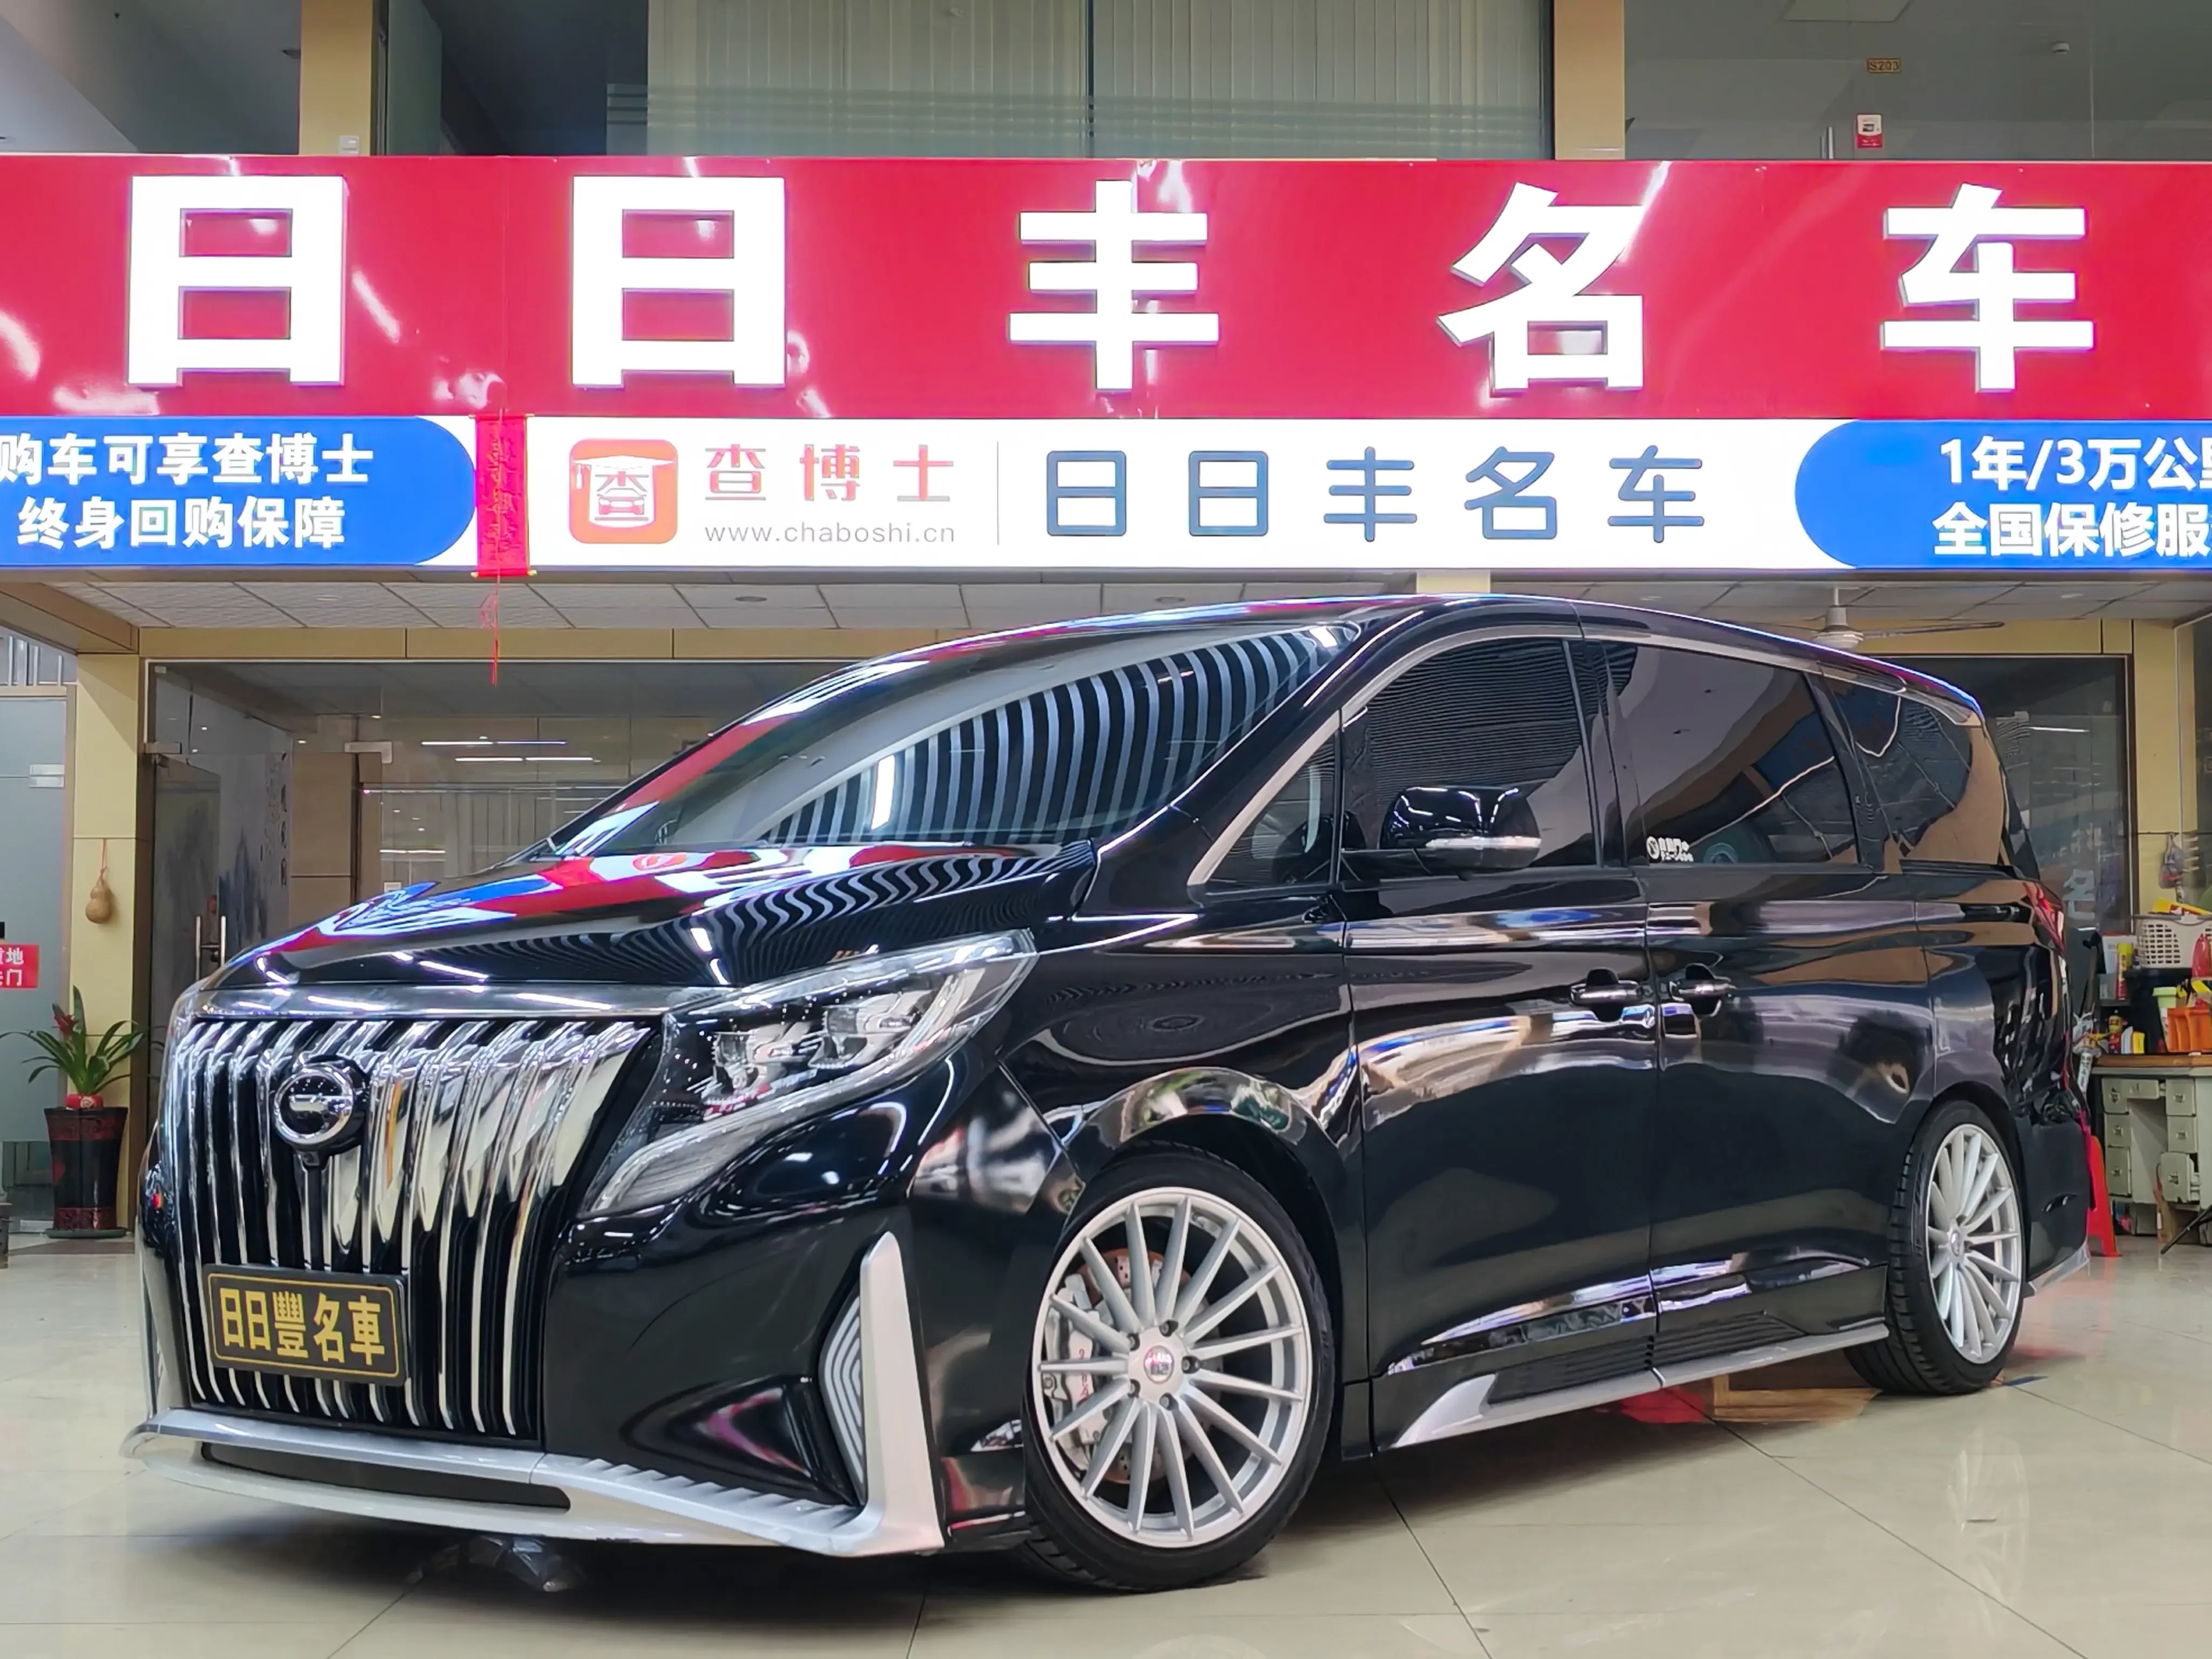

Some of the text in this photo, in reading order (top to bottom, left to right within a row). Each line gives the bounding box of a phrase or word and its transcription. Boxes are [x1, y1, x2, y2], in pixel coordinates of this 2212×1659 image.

[127, 176, 2093, 393] 日日丰名车
[0, 433, 373, 485] 购车可享查博士
[705, 443, 954, 502] 查博士
[1940, 435, 2212, 491] 1年/3万公
[1046, 444, 1705, 544] 日日丰名车
[17, 496, 345, 549] 终身回购保障
[705, 521, 955, 543] www.chaboshi.cn
[1932, 502, 2212, 557] 全国保修服
[0, 947, 24, 965] 地
[0, 968, 23, 986] 门
[219, 1287, 385, 1365] 日日豐名車
